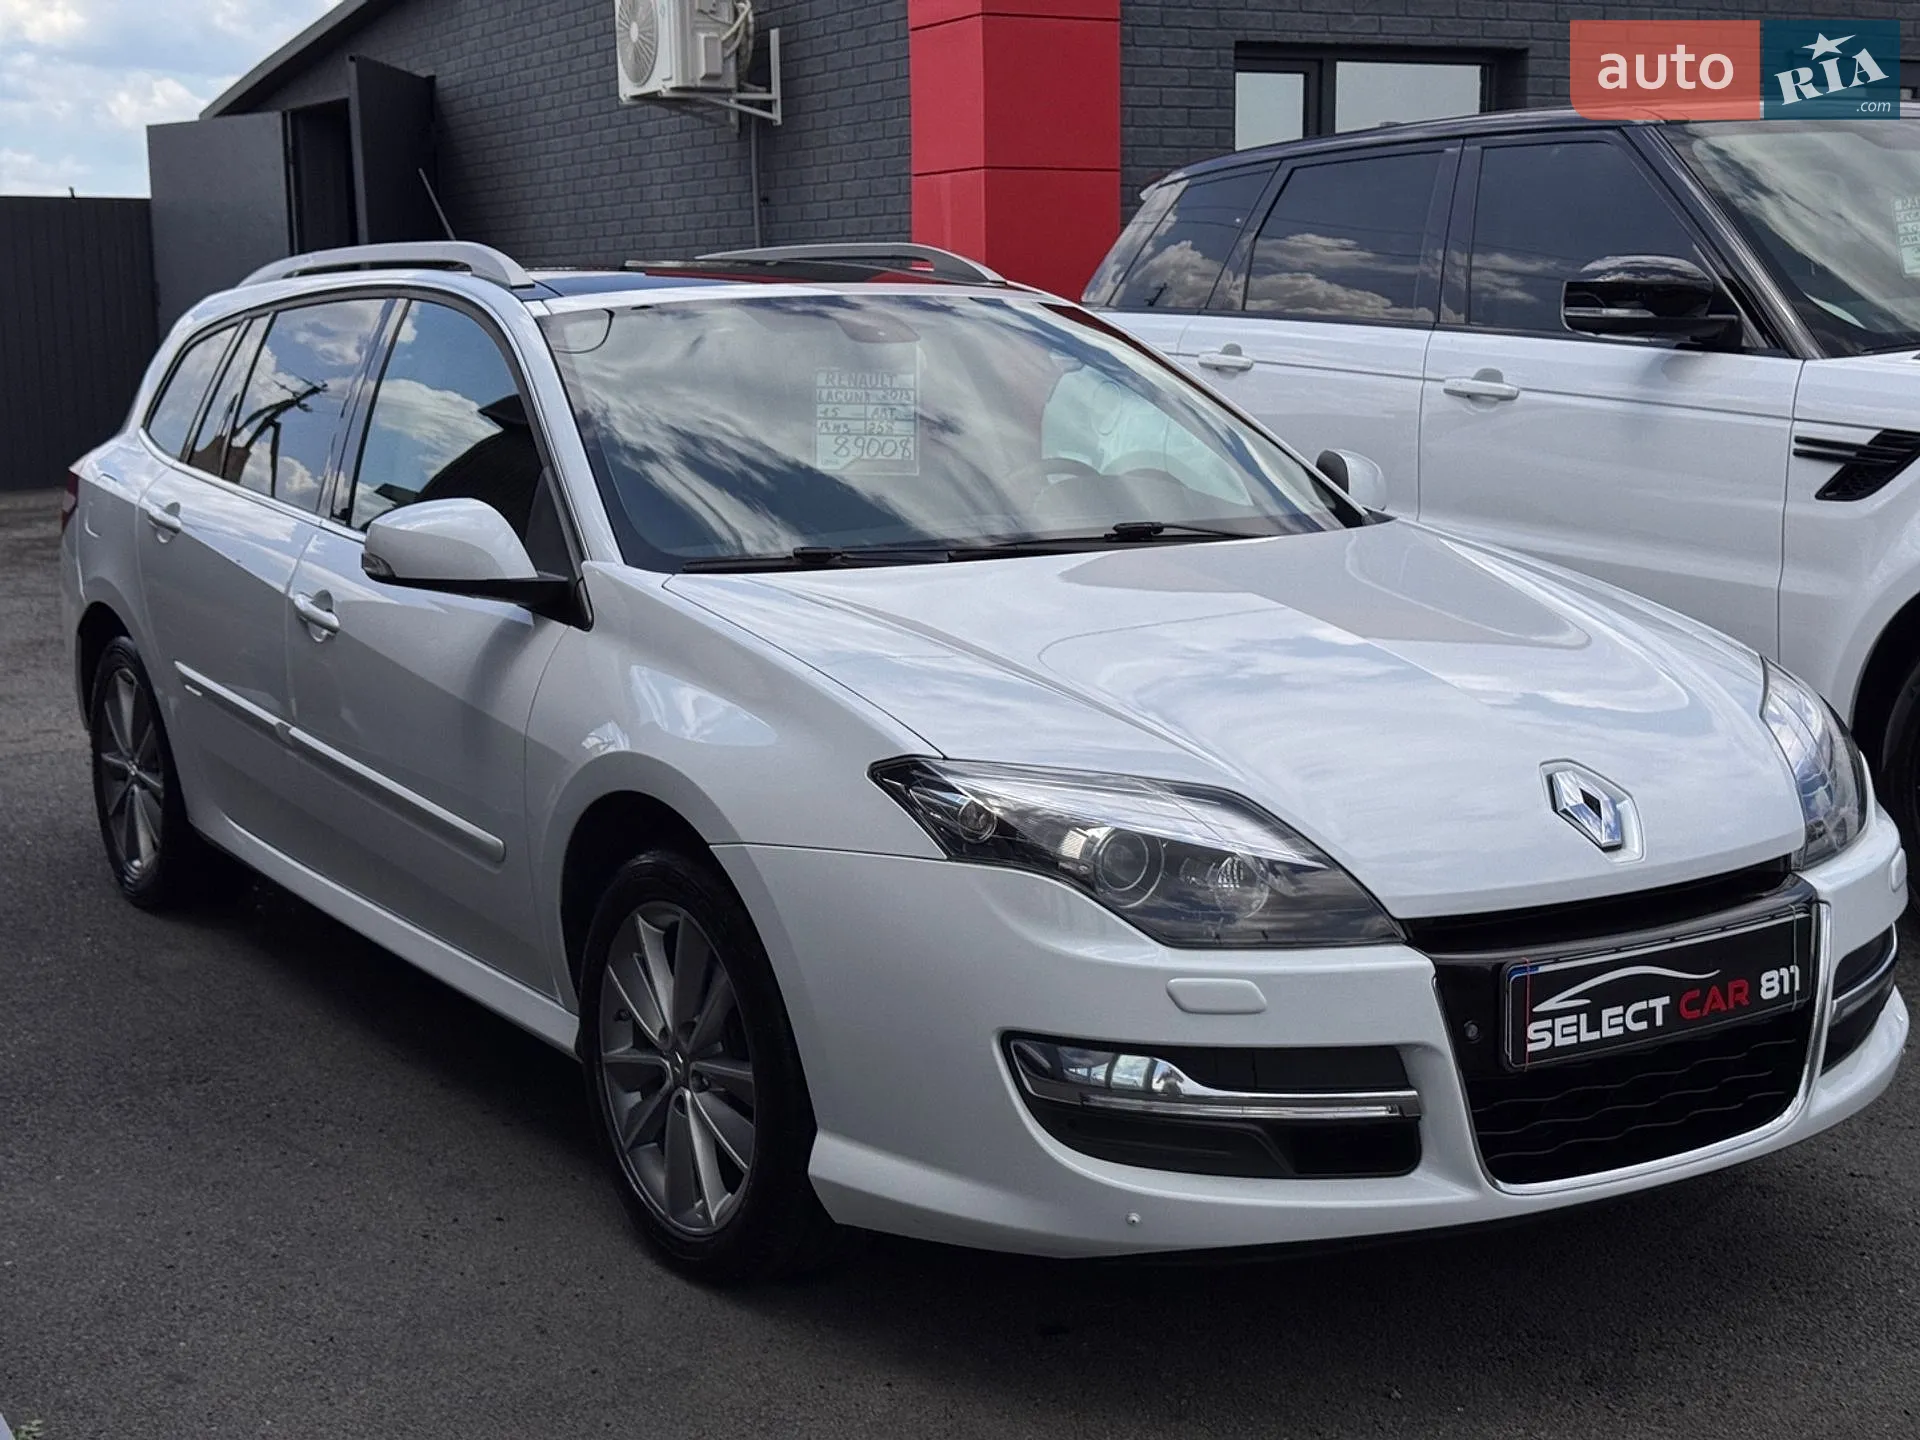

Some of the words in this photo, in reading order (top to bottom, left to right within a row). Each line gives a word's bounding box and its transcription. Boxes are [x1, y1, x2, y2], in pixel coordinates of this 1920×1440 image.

[825, 372, 894, 388] RENAULT
[1526, 996, 1670, 1052] SELECT
[1679, 979, 1750, 1020] CAR
[1759, 965, 1801, 1001] 811
